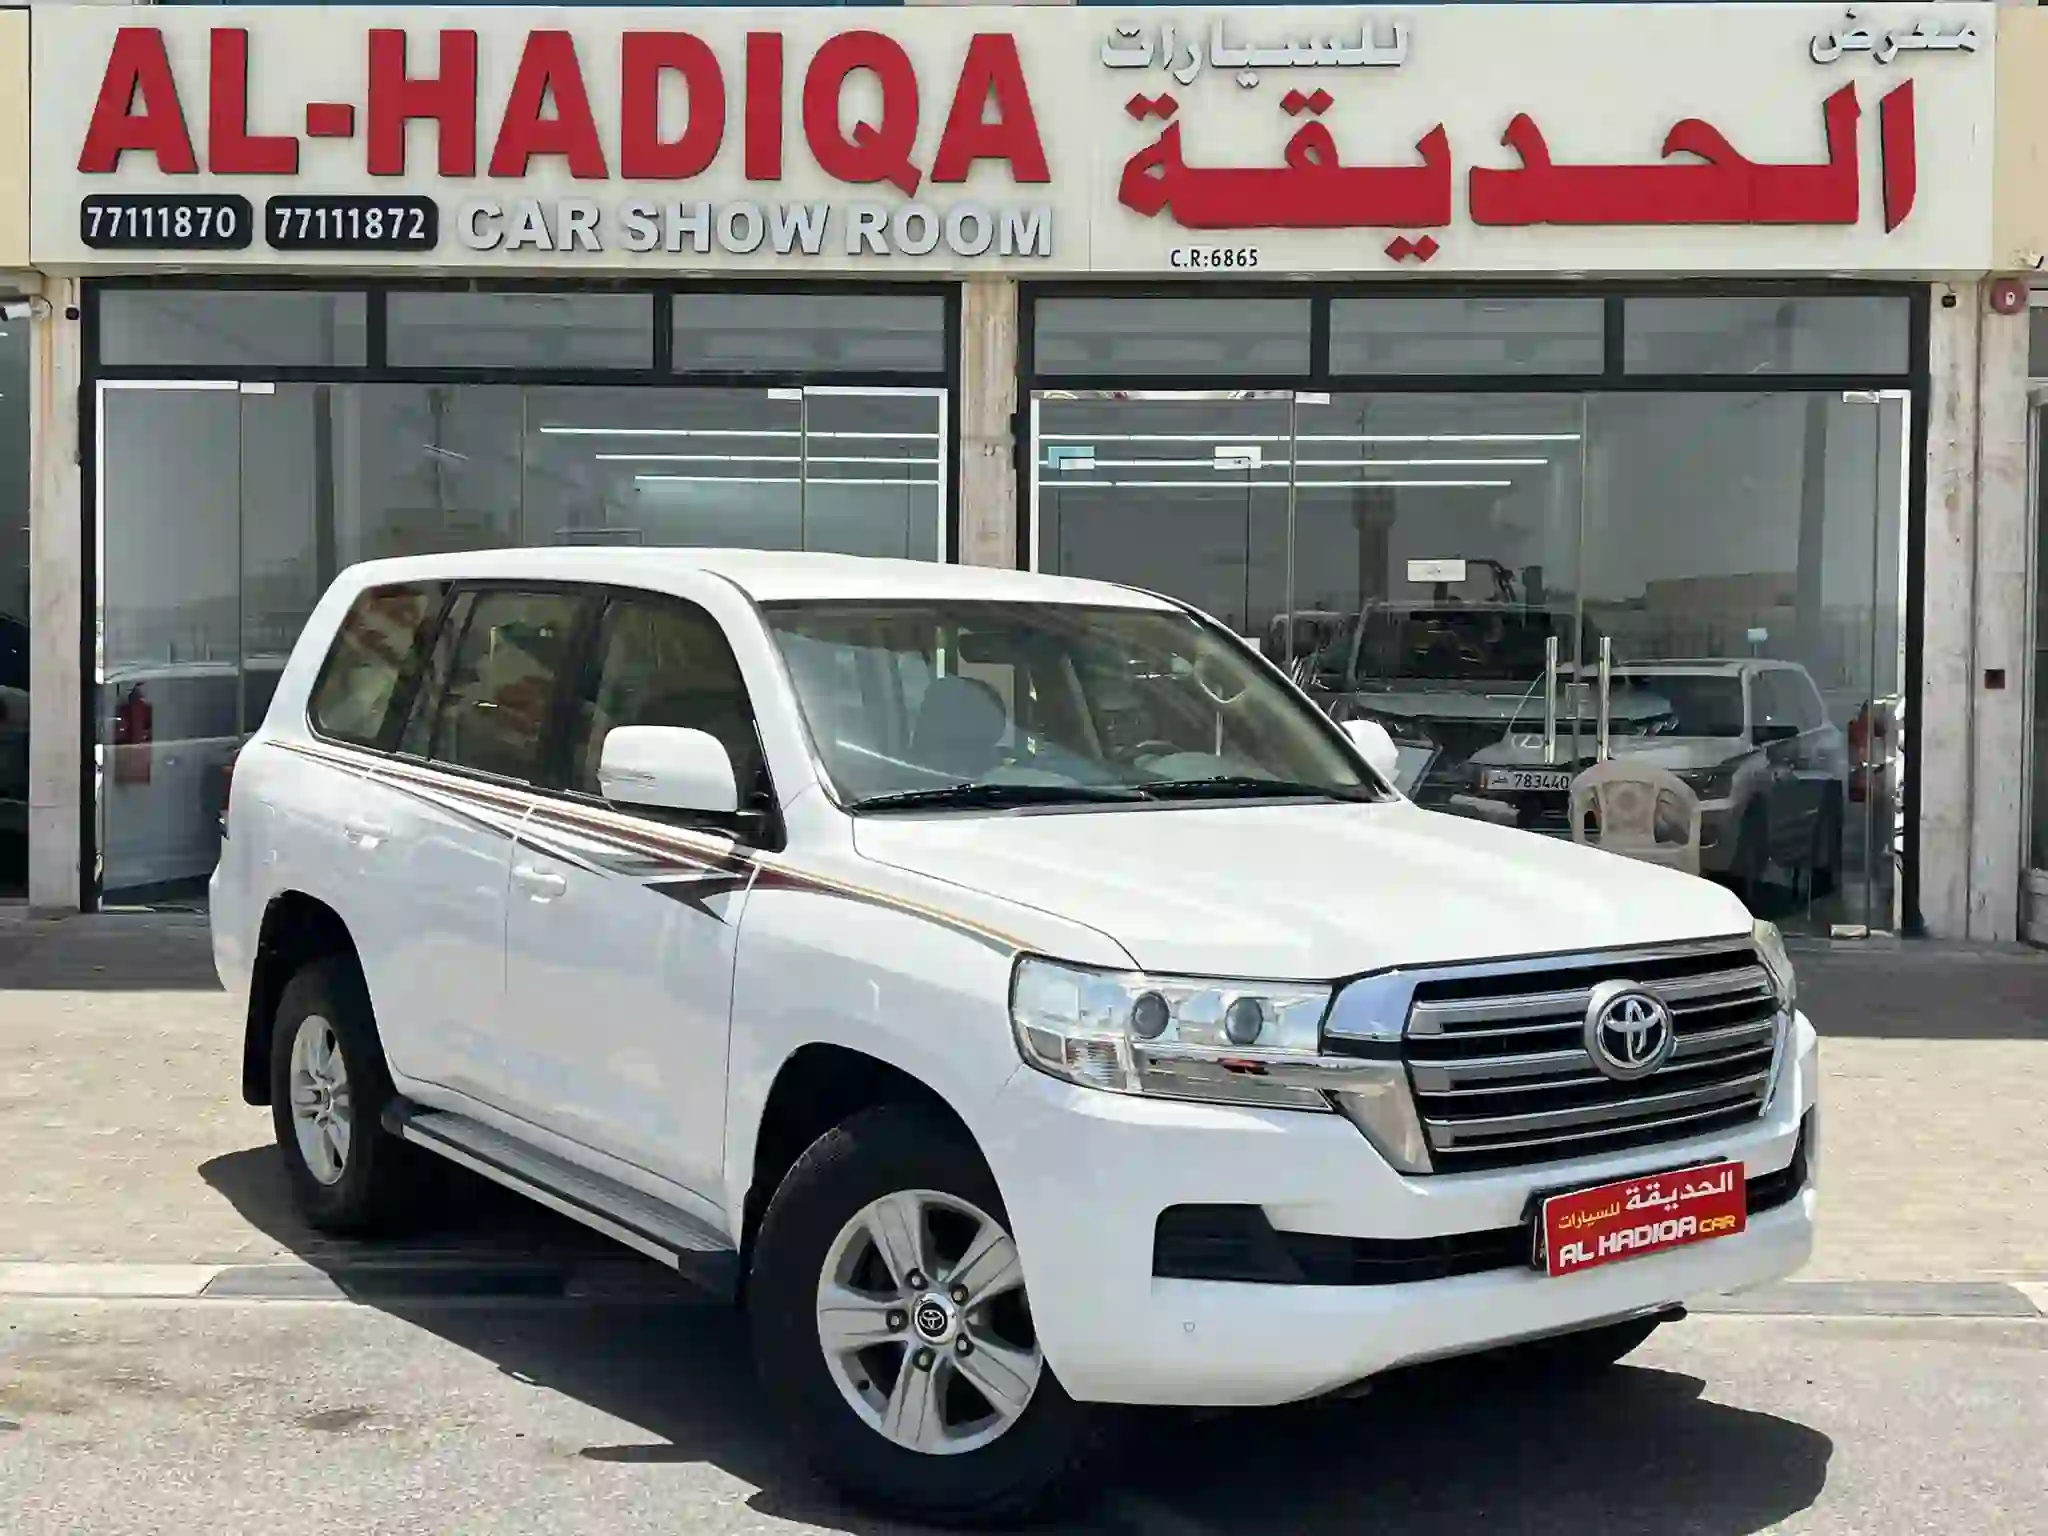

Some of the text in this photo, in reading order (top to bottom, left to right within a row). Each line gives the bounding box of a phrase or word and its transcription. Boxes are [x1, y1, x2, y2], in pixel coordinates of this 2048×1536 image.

[1100, 19, 1410, 88] للسيارات
[1810, 8, 1977, 64] معرض
[78, 27, 1051, 198] AL-HADIQA
[1117, 78, 1917, 263] الحديقة
[86, 206, 237, 238] 77111870
[274, 208, 426, 240] 77111872
[457, 200, 1053, 257] CAR SHOW ROOM
[1170, 248, 1258, 267] C.R:6865
[1514, 774, 1569, 789] 783440
[1558, 1169, 1733, 1230] الحديقة للسيارات
[1559, 1240, 1595, 1268] AL
[1699, 1214, 1737, 1234] CAR
